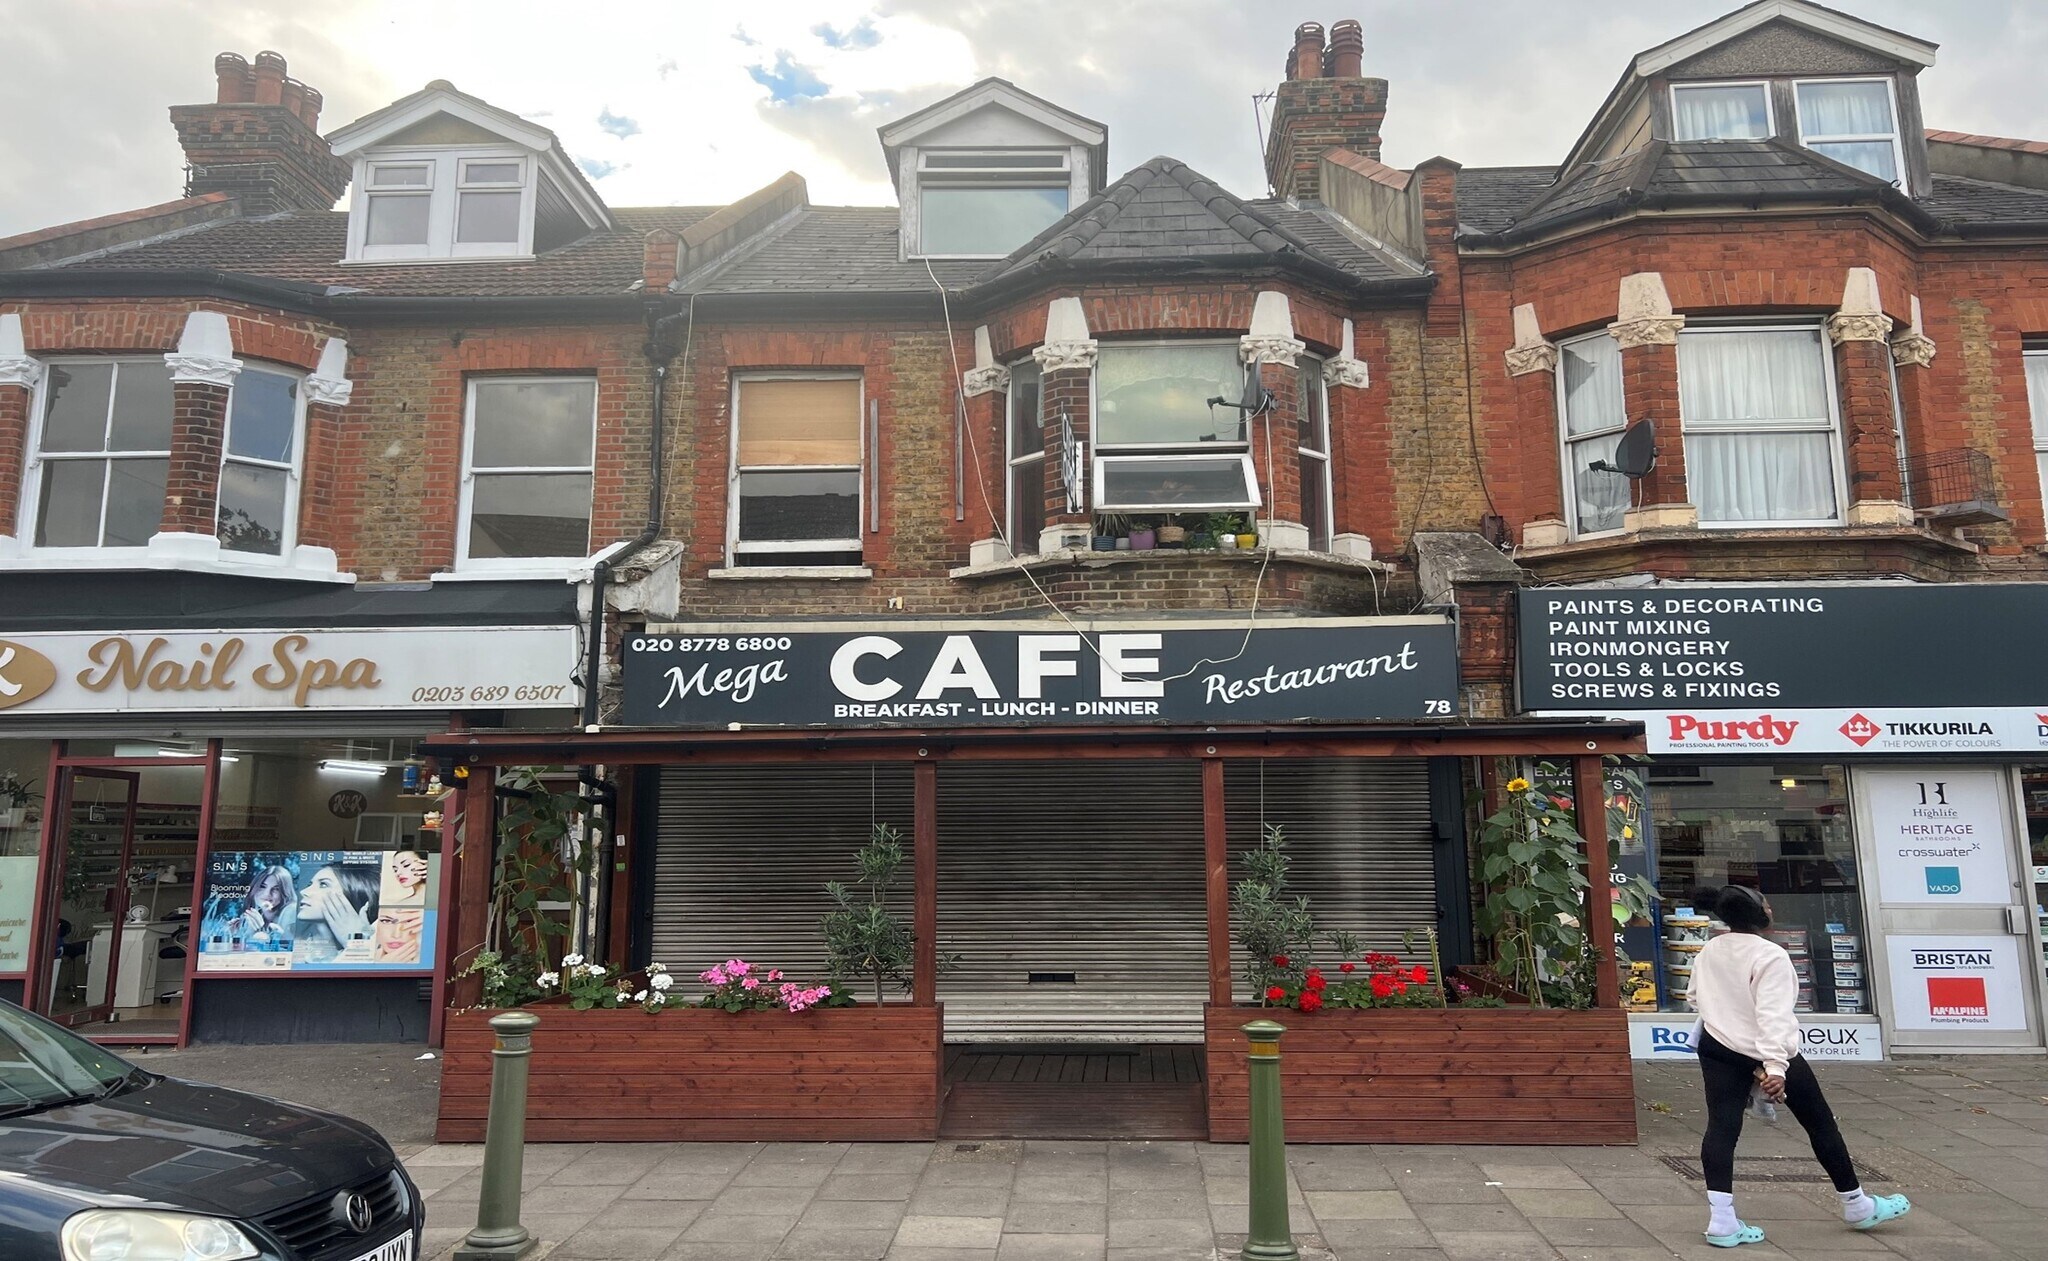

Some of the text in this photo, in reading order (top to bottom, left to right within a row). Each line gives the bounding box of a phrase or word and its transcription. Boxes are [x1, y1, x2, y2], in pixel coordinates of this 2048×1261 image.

[1548, 598, 1824, 615] PAINTS & DECORATING
[1549, 620, 1711, 636] PAINT MIXING
[632, 637, 792, 652] 020 8778 6800
[1549, 641, 1730, 656] IRONMONGERY
[76, 637, 245, 691] Nail
[252, 635, 383, 707] Spa
[829, 633, 1165, 701] CAFE
[1202, 641, 1418, 704] Restaurant
[1550, 661, 1744, 677] TOOLS & LOCKS
[657, 659, 788, 709] Mega
[1551, 682, 1781, 698] SCREWS & FIXINGS
[411, 684, 566, 702] 0203 689 6507
[834, 703, 961, 717] BREAKFAST
[982, 702, 1055, 716] LUNCH
[1075, 701, 1159, 715] DINNER
[1424, 701, 1451, 714] 78
[1666, 714, 1799, 746] Purdy
[1886, 722, 1993, 735] TIKKURILA
[1882, 740, 1900, 748] THE
[1955, 739, 2001, 747] COLOURS
[1913, 809, 1958, 820] Highlife
[1901, 825, 1974, 834] HERITAGE
[210, 884, 251, 893] Blooming
[1929, 885, 1959, 893] VADO
[1915, 953, 1991, 965] BRISTAN
[1841, 1047, 1860, 1055] LIFE
